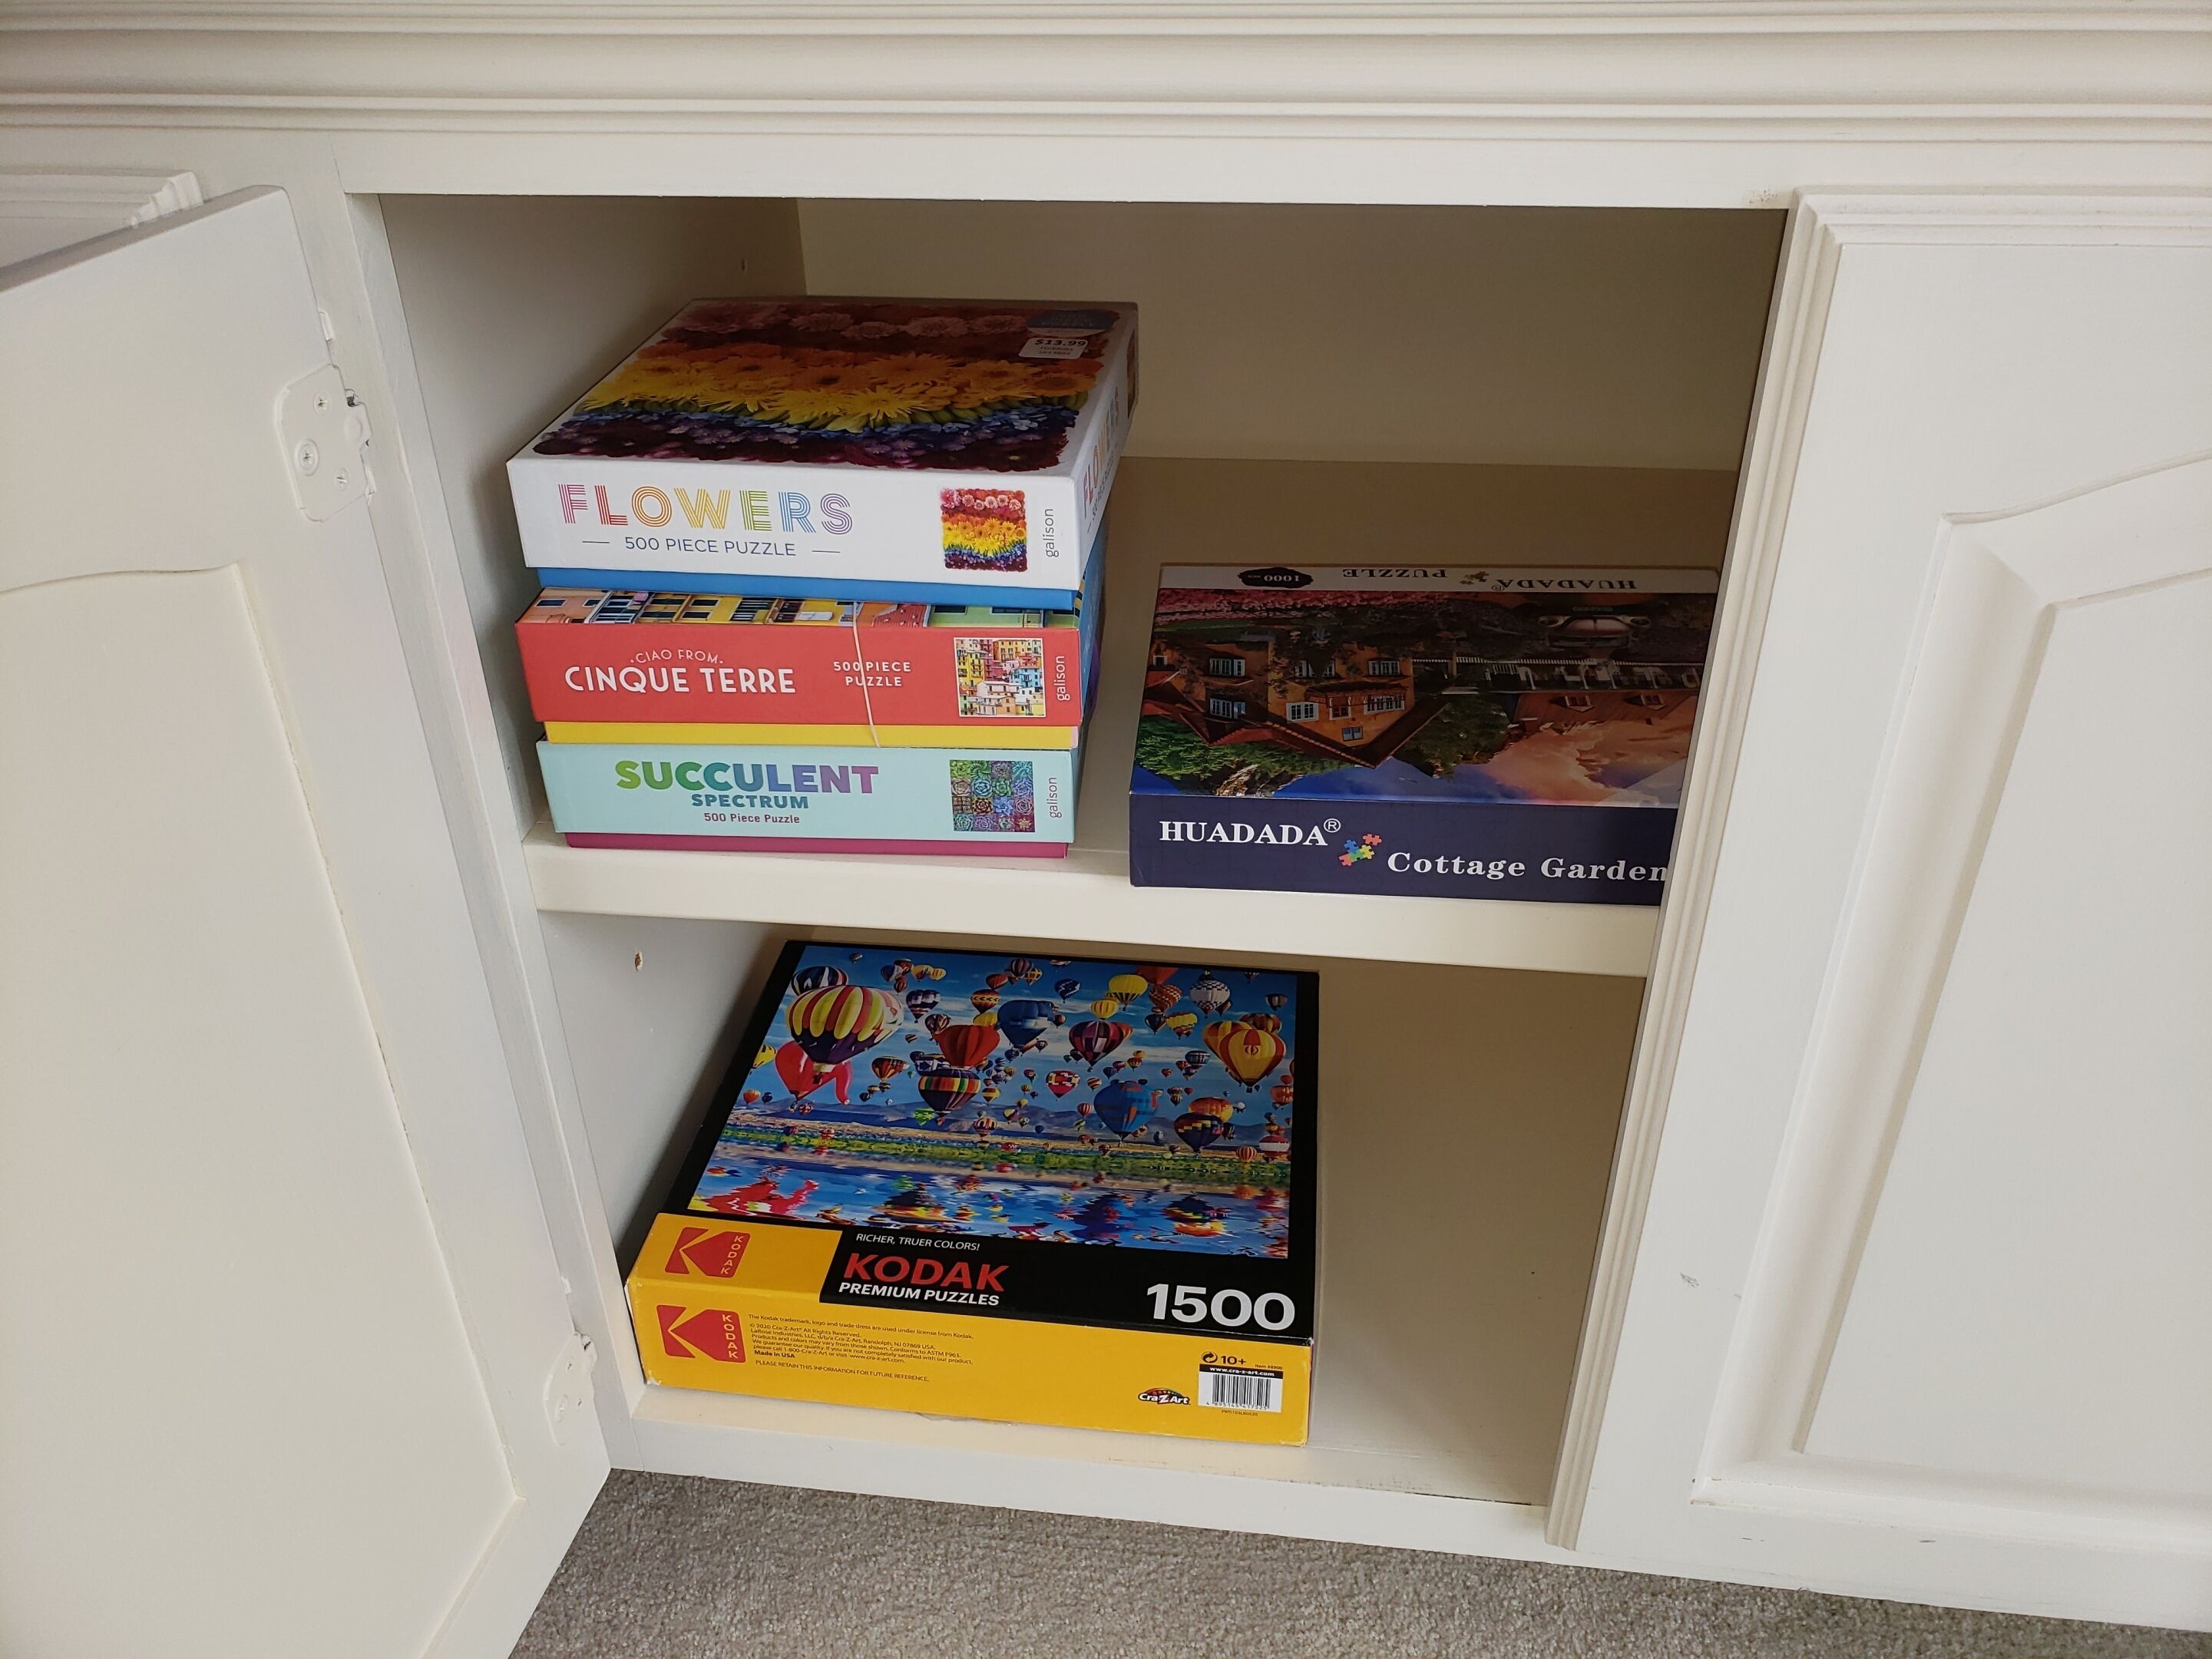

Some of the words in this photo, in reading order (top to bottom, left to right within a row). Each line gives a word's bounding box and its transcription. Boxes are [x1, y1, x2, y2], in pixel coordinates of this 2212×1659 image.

[557, 484, 853, 535] FLOWERS
[1042, 508, 1060, 557] galison
[625, 537, 660, 550] 500
[666, 538, 719, 553] PIECE
[724, 541, 797, 557] PUZZLE
[1342, 568, 1448, 578] PUZZLE
[635, 649, 673, 664] CIAO
[677, 649, 719, 664] FROM
[833, 661, 861, 672] 500
[865, 661, 911, 672] PIECE
[564, 666, 690, 693] CINQUE
[699, 667, 796, 693] TERRE
[845, 676, 902, 687] PUZZLE
[1053, 656, 1071, 701] galison
[614, 760, 879, 795] SUCCULENT
[691, 793, 809, 809] SPECTRUM
[1046, 777, 1063, 818] galison
[703, 812, 726, 823] 500
[729, 812, 761, 824] Piece
[764, 814, 800, 825] Puzzle
[1387, 851, 1526, 881] Cottage
[1540, 857, 1668, 881] Garden
[855, 1233, 896, 1246] RICHER,
[898, 1236, 932, 1248] TRUER
[934, 1239, 980, 1251] COLORS!
[720, 1235, 744, 1275] KODAK
[843, 1252, 1010, 1293] KODAK
[838, 1281, 921, 1300] PREMIUM
[924, 1289, 1000, 1307] PUZZLES
[1146, 1283, 1296, 1331] 1500
[779, 1317, 812, 1325] trademark,
[722, 1314, 739, 1360] KODAK
[772, 1330, 804, 1338] Industries,
[864, 1350, 898, 1359] completely
[890, 1346, 918, 1354] Conforms
[1220, 1355, 1247, 1365] 10+
[813, 1365, 856, 1374] INFORMATION
[894, 1373, 930, 1382] REFERENCE.
[1209, 1366, 1275, 1377] www.cra-z-art.com
